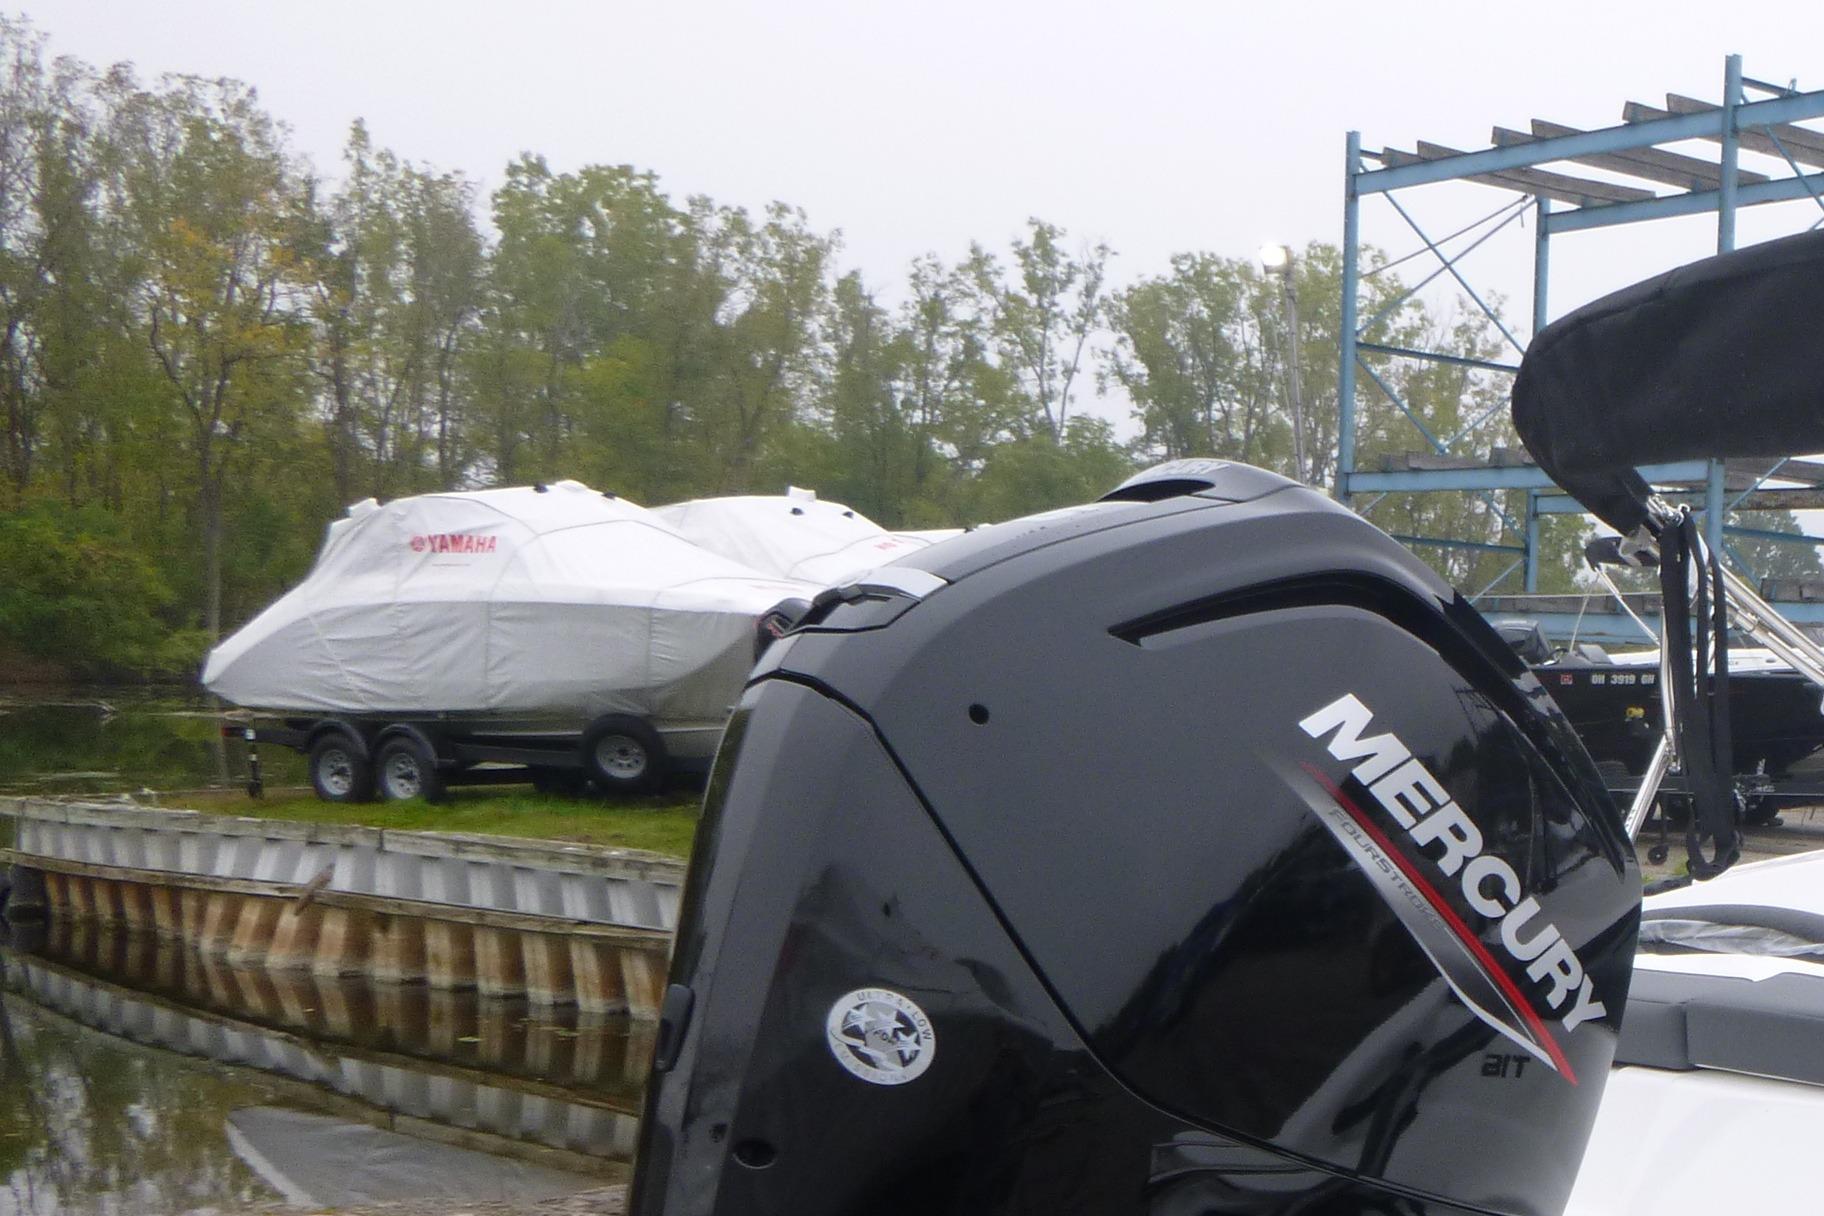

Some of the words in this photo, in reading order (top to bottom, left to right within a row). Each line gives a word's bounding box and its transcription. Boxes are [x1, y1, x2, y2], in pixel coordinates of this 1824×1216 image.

[428, 534, 497, 554] YAMAHA
[1610, 674, 1637, 685] 3919
[1298, 692, 1607, 1033] MERCURY
